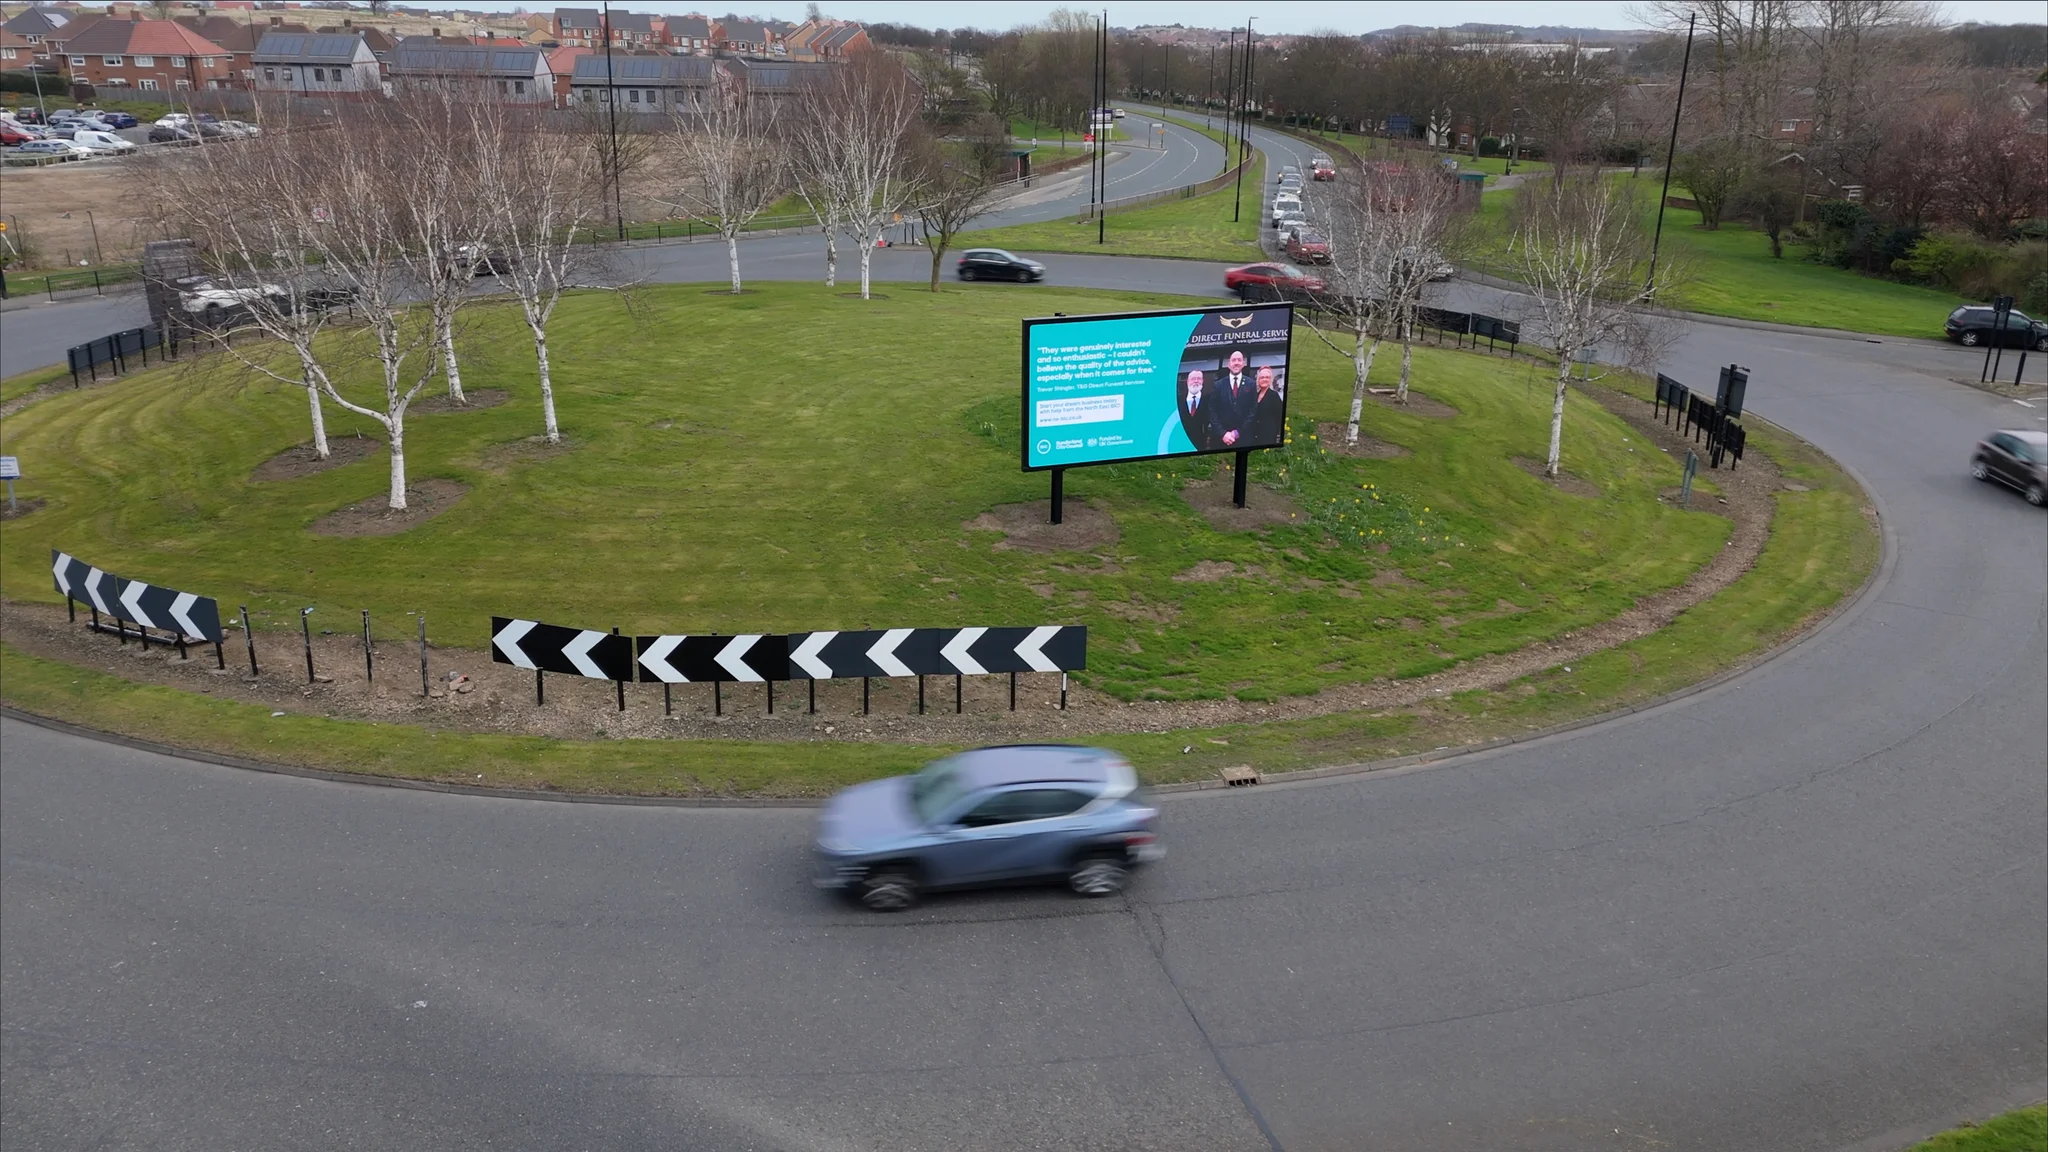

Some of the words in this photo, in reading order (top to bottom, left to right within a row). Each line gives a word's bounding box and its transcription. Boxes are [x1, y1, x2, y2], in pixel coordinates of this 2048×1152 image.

[1191, 333, 1222, 343] DIRECT
[1224, 330, 1261, 341] FUNERAL
[1262, 329, 1288, 338] SERVIC
[1079, 342, 1114, 353] genuinely
[1115, 339, 1151, 348] interested
[1062, 352, 1106, 362] enthusiastic
[1036, 364, 1064, 373] believe
[1065, 363, 1077, 371] the
[1078, 361, 1102, 370] quality
[1103, 360, 1112, 368] of
[1113, 359, 1125, 367] the
[1036, 371, 1073, 382] especially
[1074, 370, 1094, 379] when
[1101, 369, 1126, 377] comes
[1126, 367, 1137, 375] for
